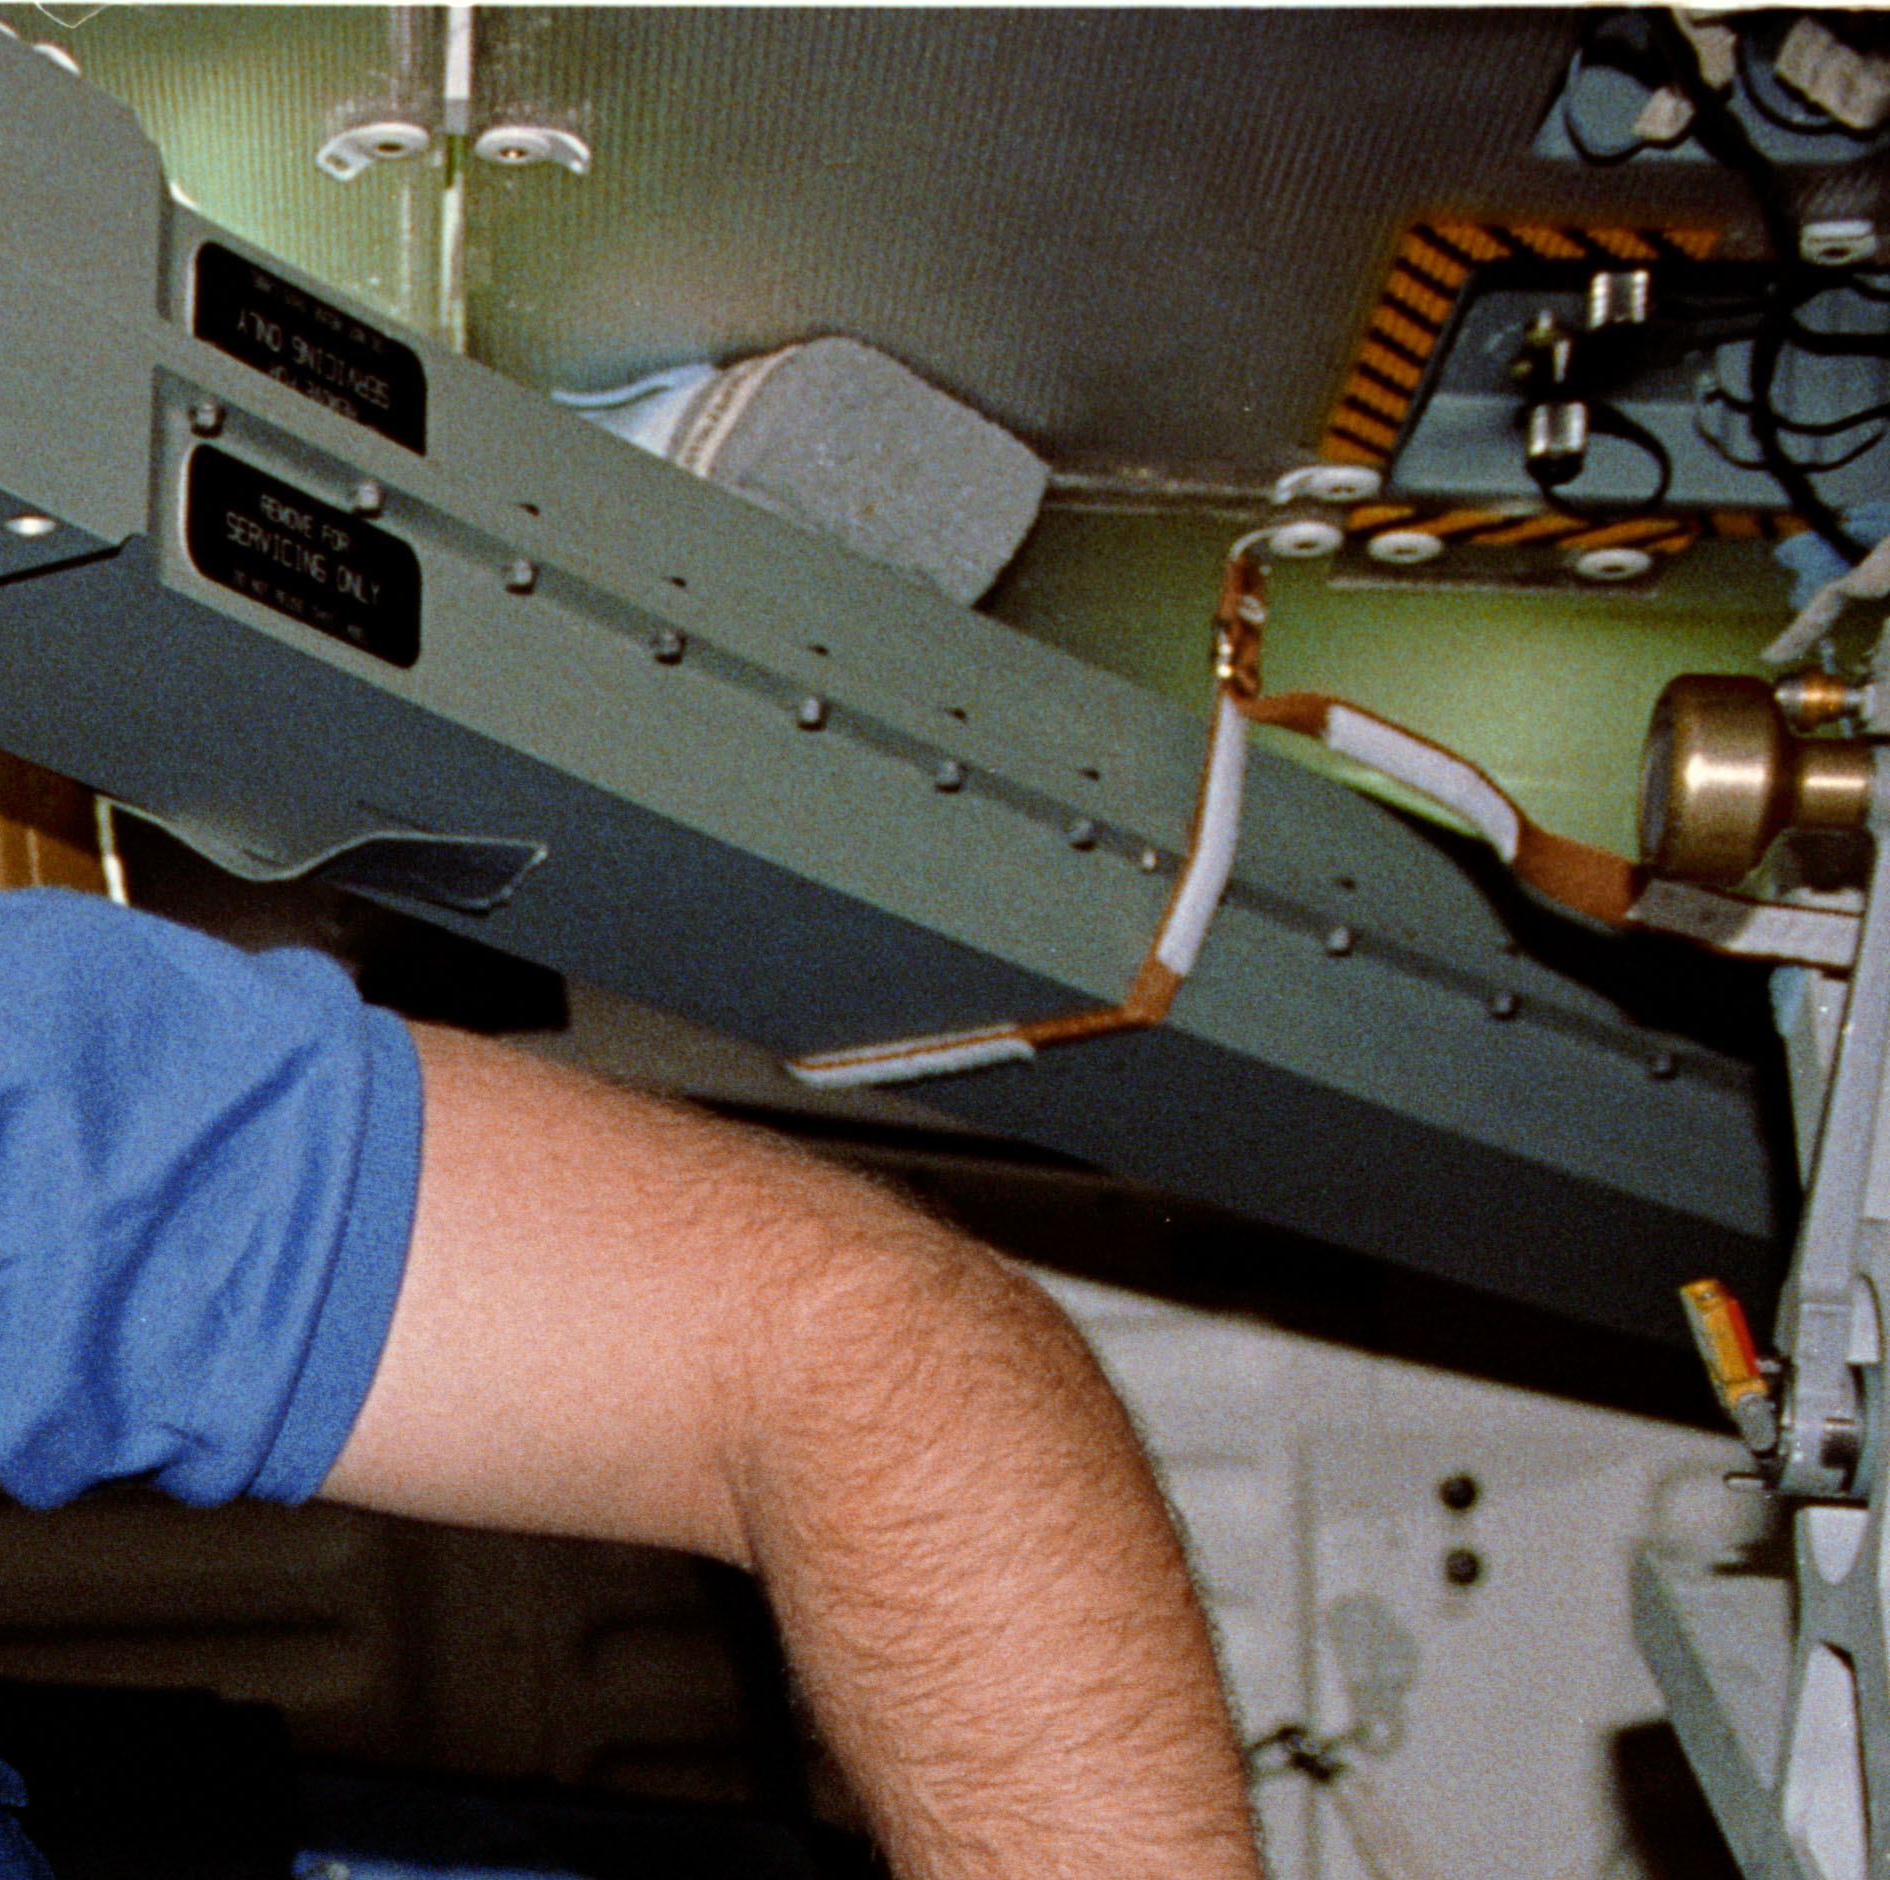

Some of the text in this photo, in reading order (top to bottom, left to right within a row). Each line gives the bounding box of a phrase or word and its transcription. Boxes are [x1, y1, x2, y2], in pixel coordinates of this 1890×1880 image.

[226, 511, 381, 605] SERVICING ONLY
[261, 493, 350, 552] REMOVE FOR
